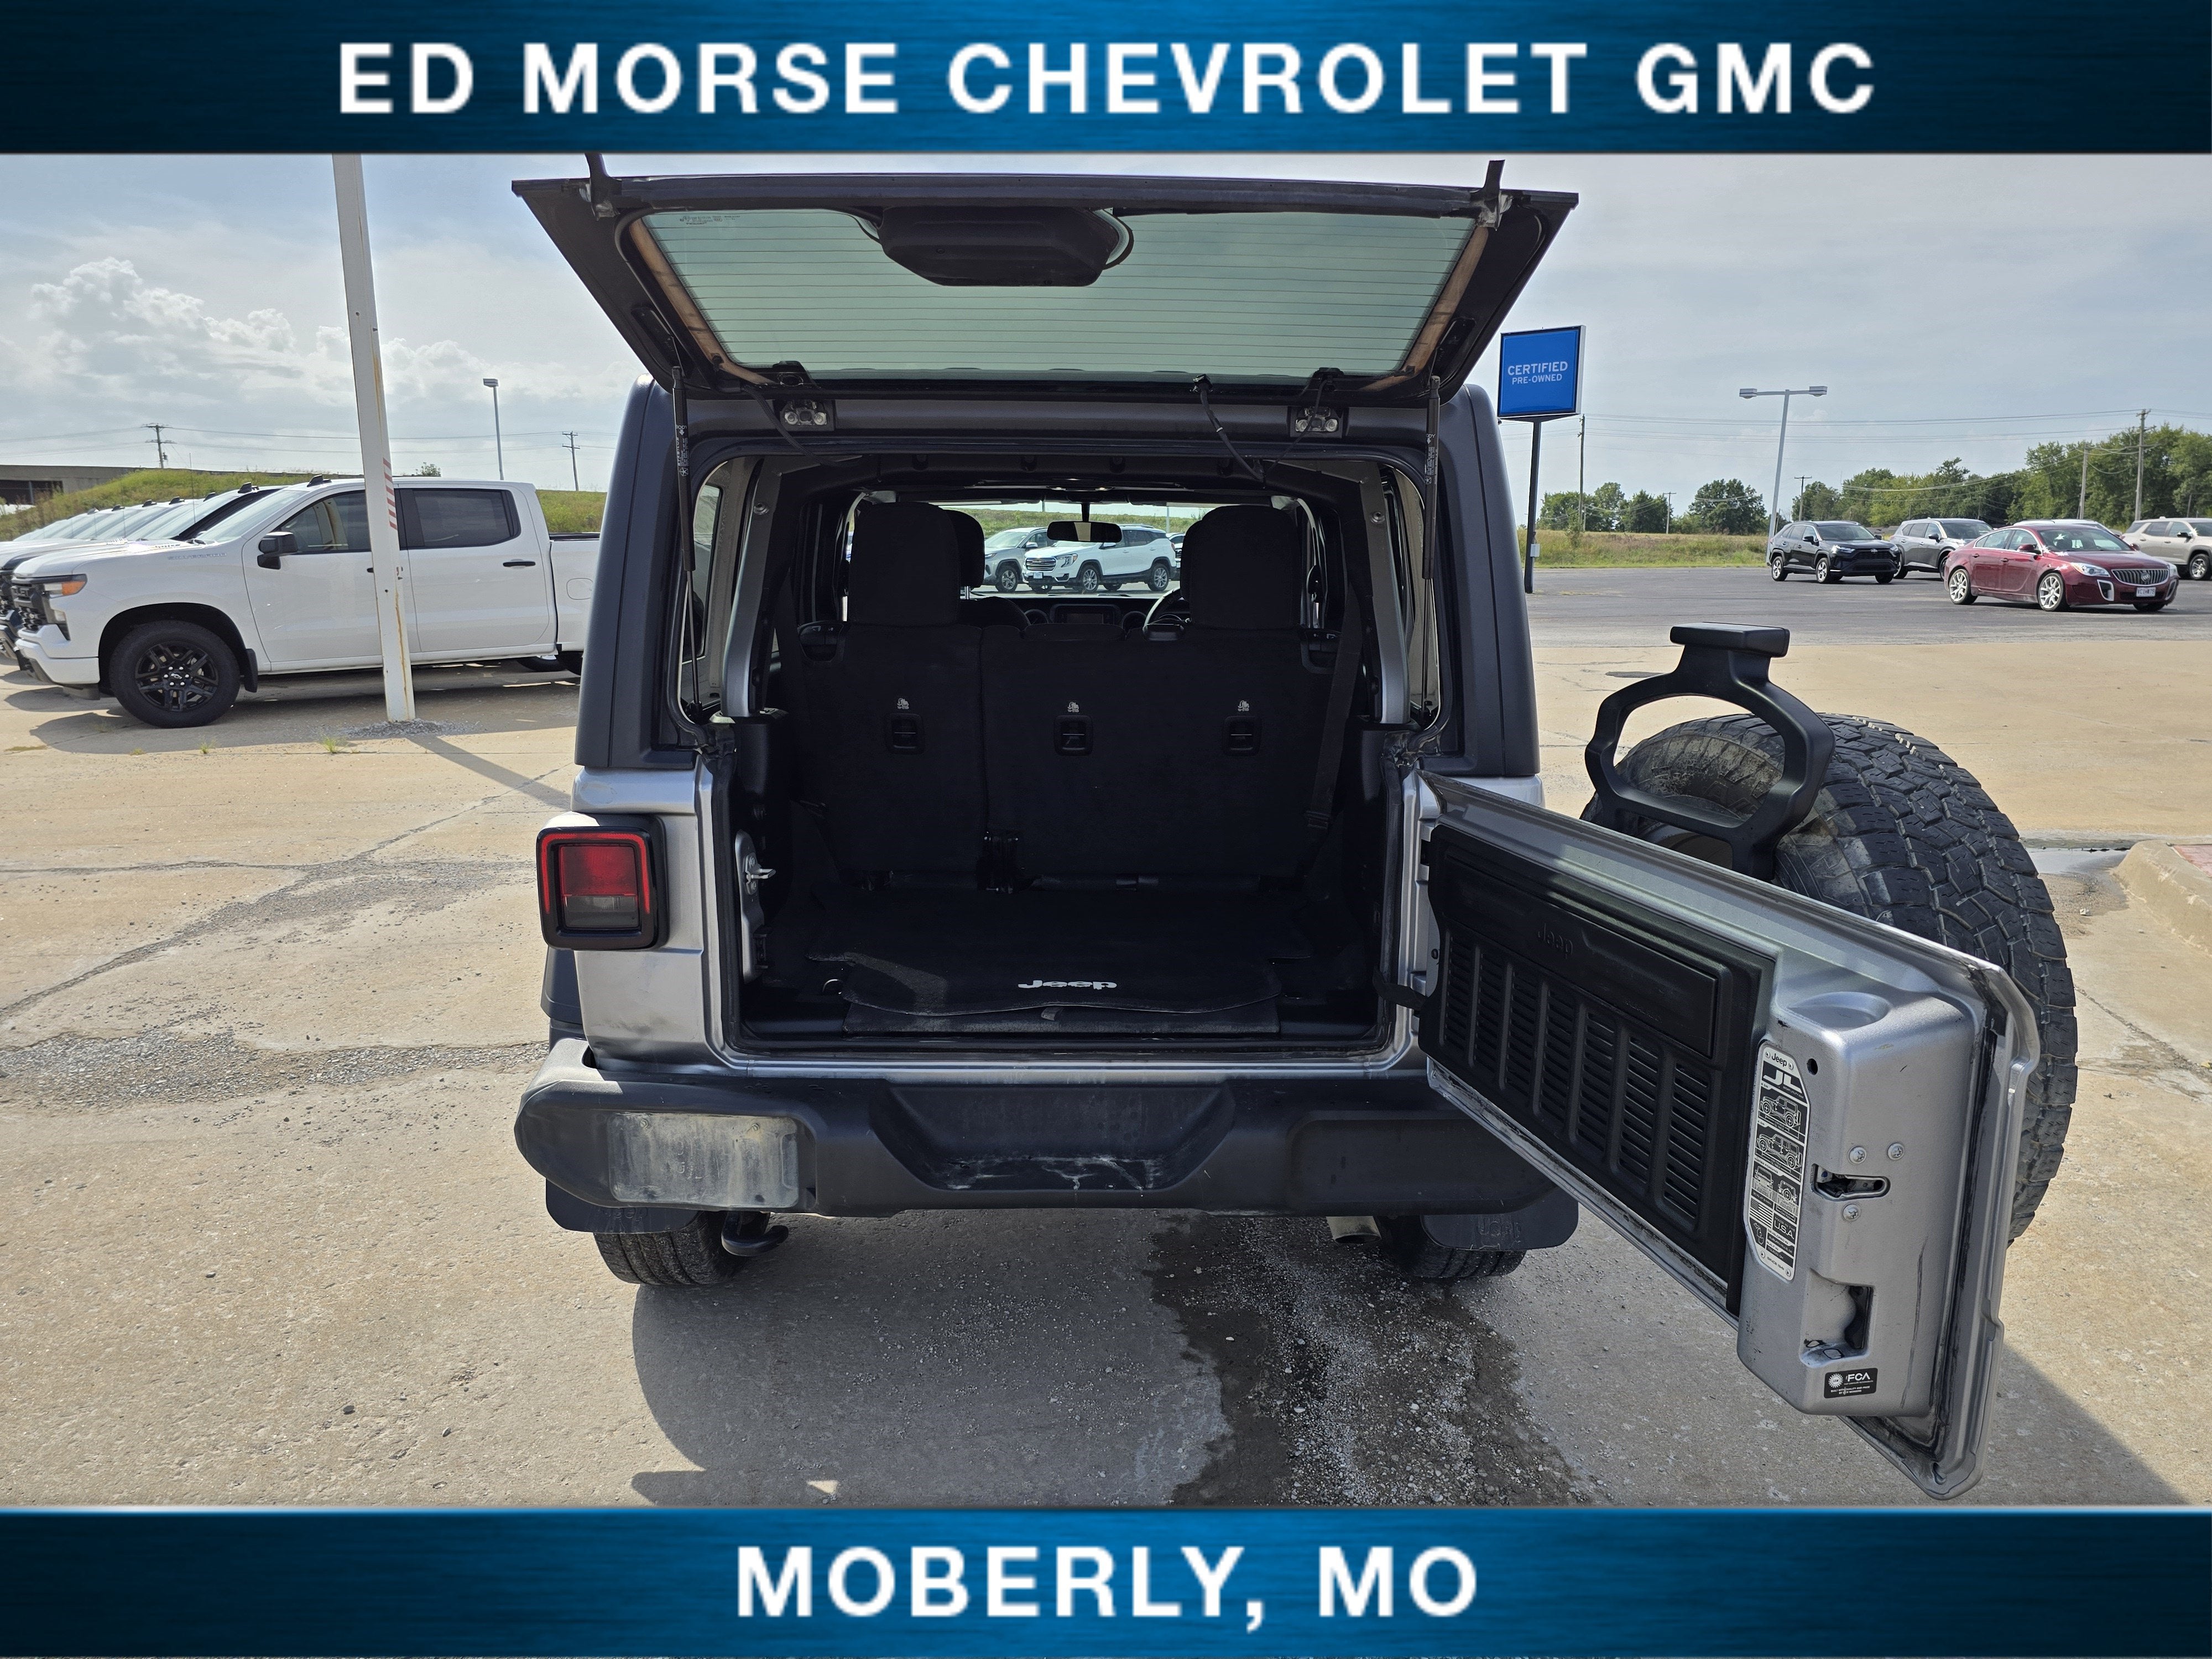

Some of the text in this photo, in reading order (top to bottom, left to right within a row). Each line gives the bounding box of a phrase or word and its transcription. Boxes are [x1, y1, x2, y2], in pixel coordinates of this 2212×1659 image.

[1508, 361, 1568, 376] CERTIFIED
[1512, 374, 1563, 385] PRE-OWNED
[1537, 922, 1573, 960] Jeep
[1018, 980, 1117, 990] Jeep
[1771, 1053, 1787, 1067] Jeep
[1762, 1069, 1802, 1094] JL
[1774, 1220, 1794, 1239] U.S.A.
[1848, 1373, 1871, 1382] FCA
